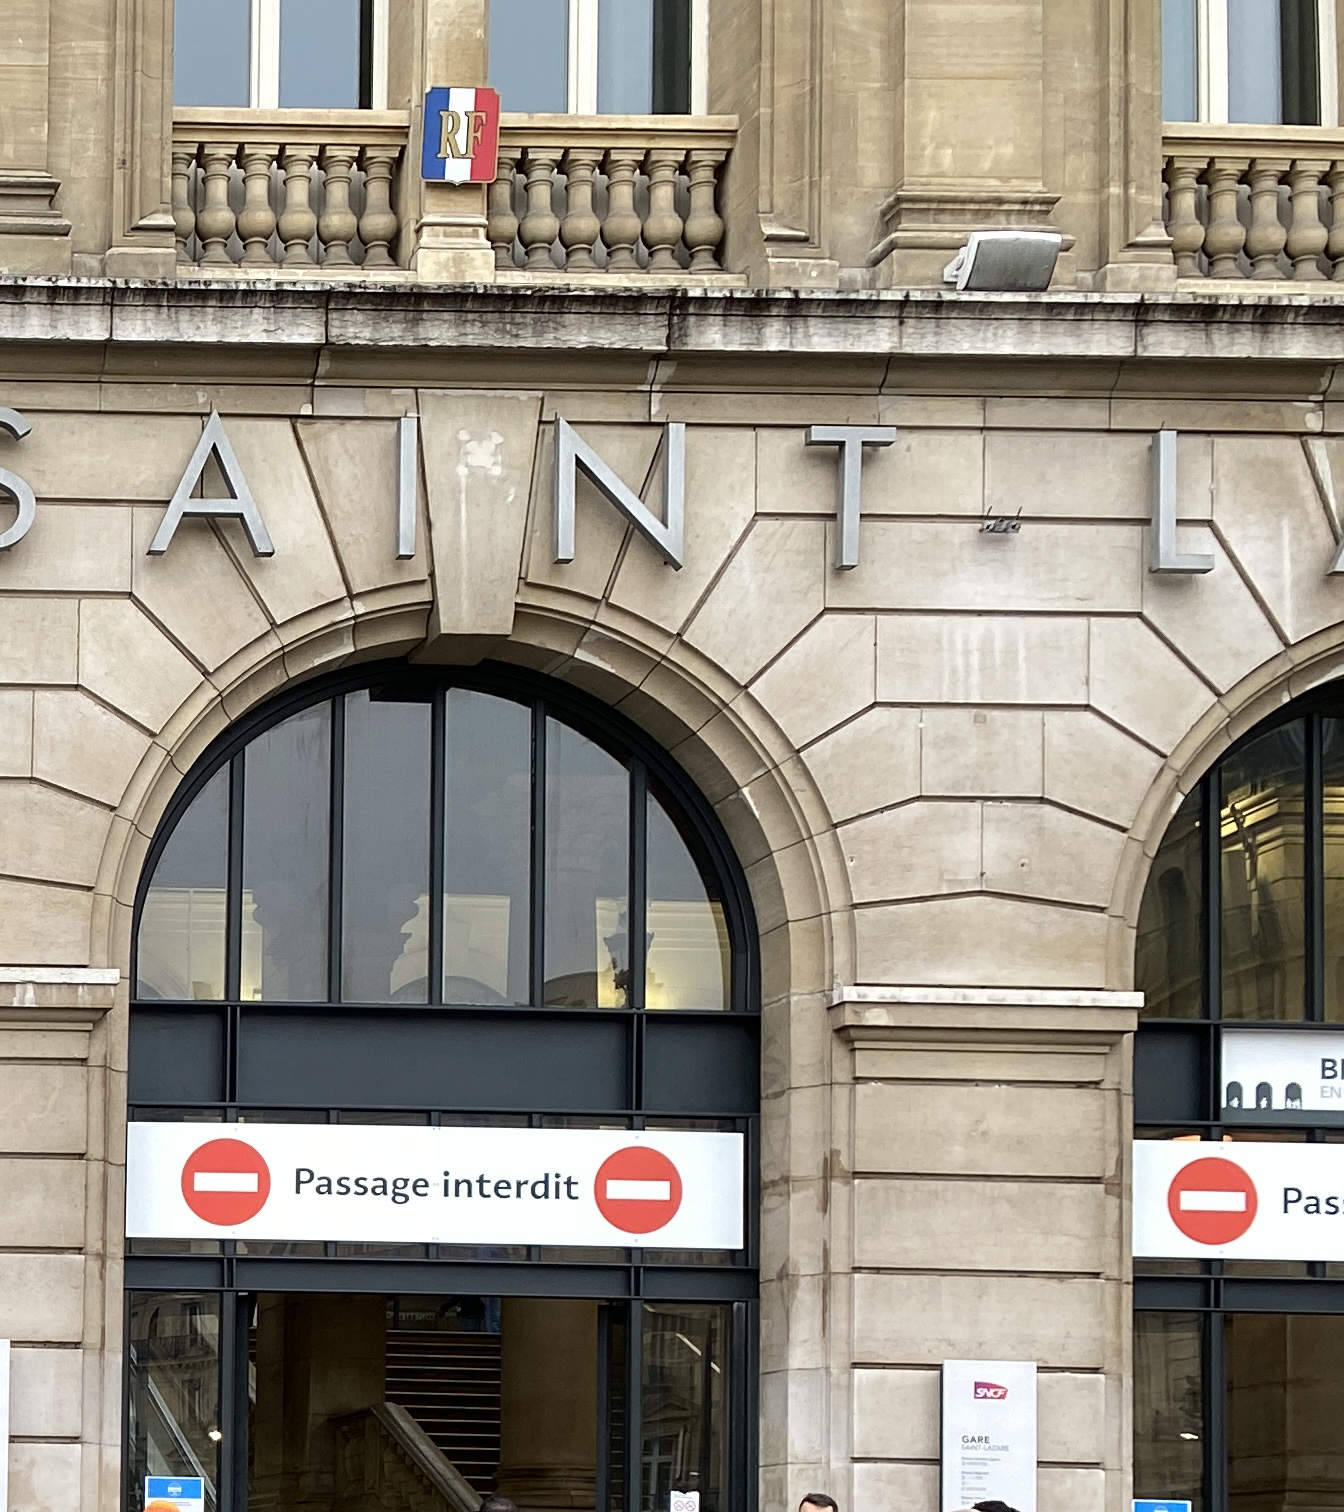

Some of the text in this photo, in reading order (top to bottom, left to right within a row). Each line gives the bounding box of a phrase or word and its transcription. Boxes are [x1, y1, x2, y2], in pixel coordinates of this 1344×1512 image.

[437, 111, 487, 159] RF
[1320, 1086, 1342, 1099] EN
[295, 1167, 579, 1204] Passage interdit
[1283, 1187, 1344, 1215] Pas
[975, 1387, 1006, 1398] SNCF
[961, 1435, 990, 1444] GARE
